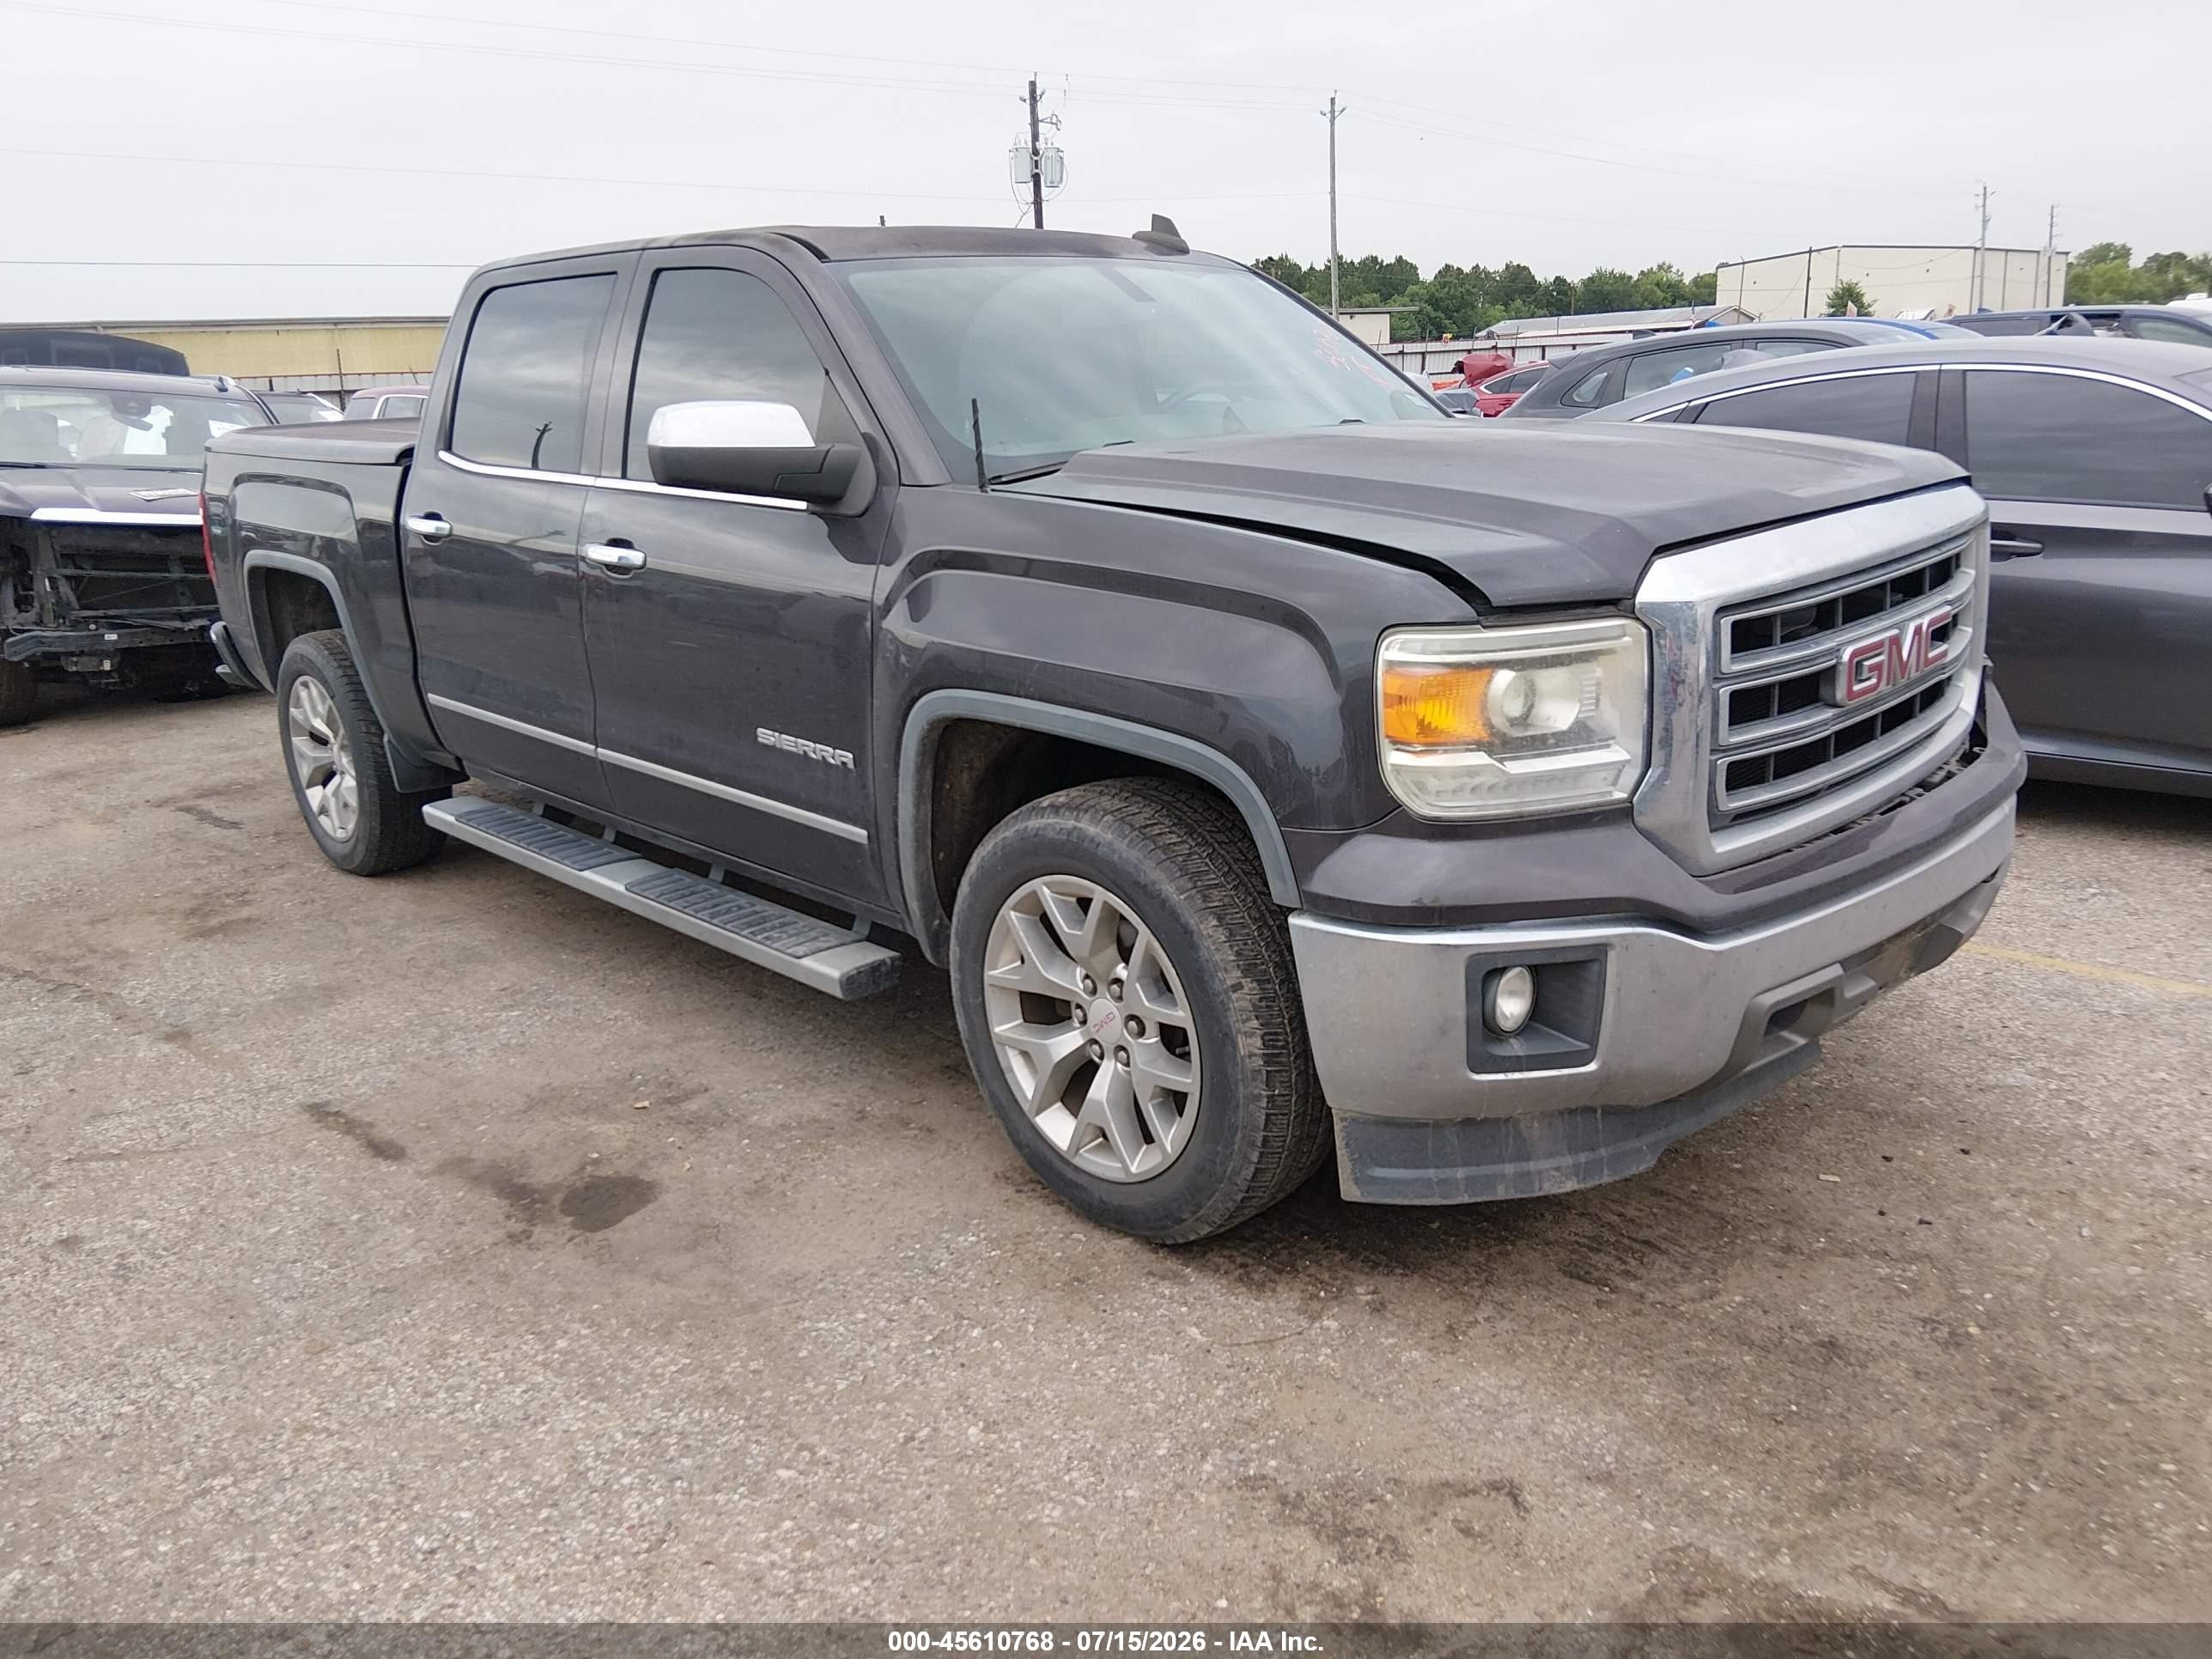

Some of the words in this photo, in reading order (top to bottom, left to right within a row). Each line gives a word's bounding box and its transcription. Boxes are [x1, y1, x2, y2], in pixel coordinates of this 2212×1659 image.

[1838, 605, 1952, 703] GMC
[756, 726, 855, 769] SIERRA
[1091, 1011, 1116, 1032] GMC
